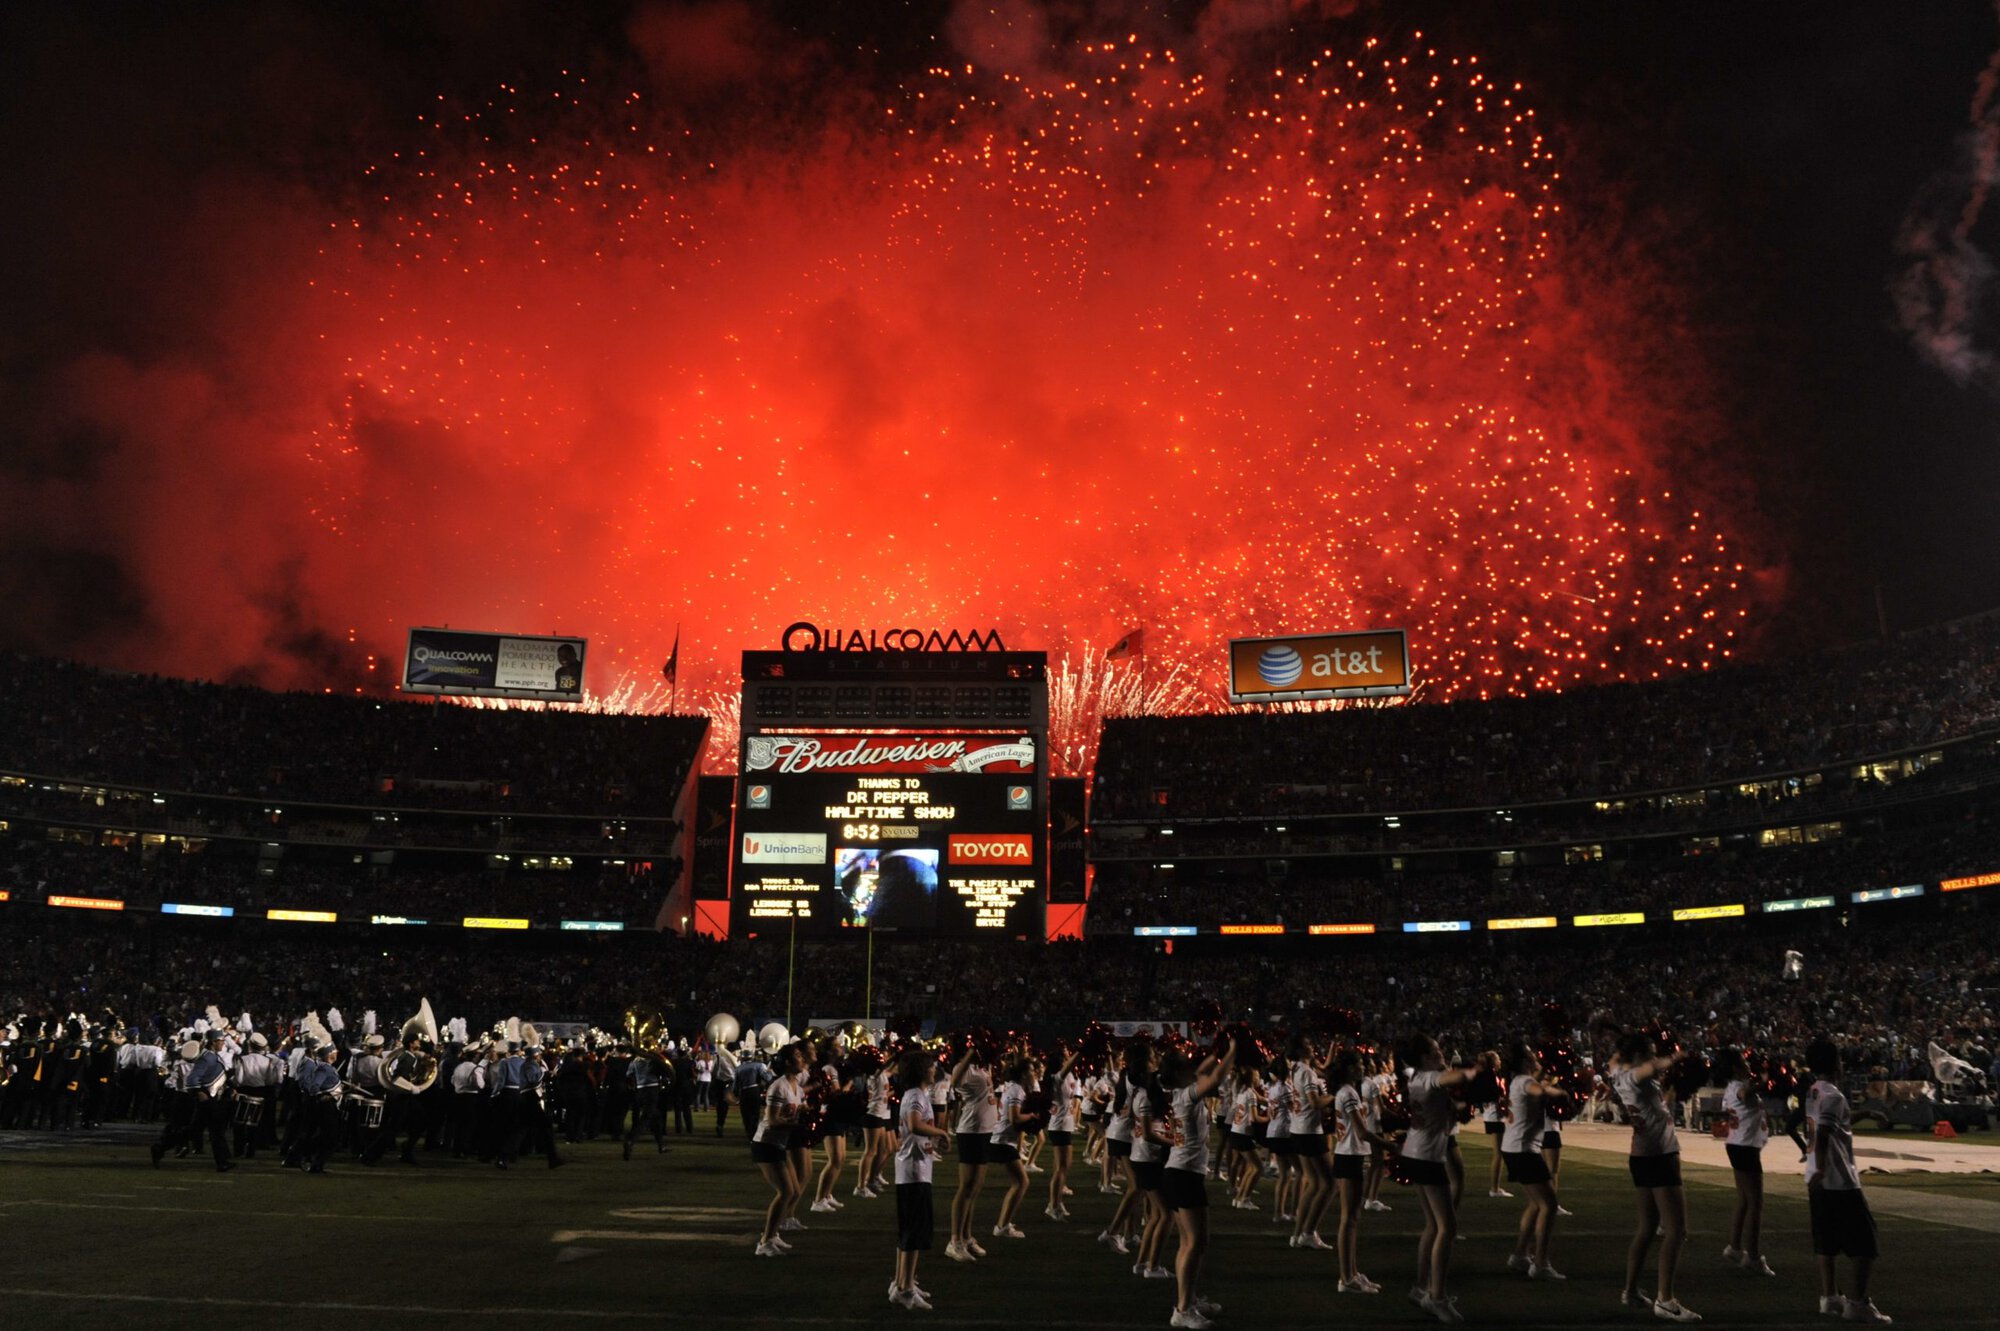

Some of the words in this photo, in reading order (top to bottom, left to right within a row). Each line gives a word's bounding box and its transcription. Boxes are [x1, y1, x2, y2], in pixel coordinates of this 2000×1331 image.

[782, 621, 1006, 651] QUALCOMM
[502, 642, 556, 653] PALOMAR
[414, 647, 493, 663] QUALCOMM
[502, 651, 555, 662] POMERADO
[1311, 645, 1383, 676] at&t
[501, 661, 555, 671] HEALTH
[772, 738, 966, 773] Budweiser
[967, 749, 1006, 767] American
[1007, 748, 1033, 760] Lager
[858, 778, 900, 789] THANKS
[905, 778, 920, 789] TO
[847, 791, 868, 803] DR
[873, 791, 929, 803] PEPPER
[825, 806, 905, 819] HALFTIME
[914, 806, 955, 819] SHOW
[843, 824, 880, 840] 8:52
[764, 844, 825, 854] UnionBank
[952, 843, 1029, 857] TOYOTA
[1011, 880, 1035, 888] LIFE
[1941, 877, 1977, 891] WELLS
[1221, 925, 1251, 933] WELLS
[1252, 925, 1283, 933] FARGO
